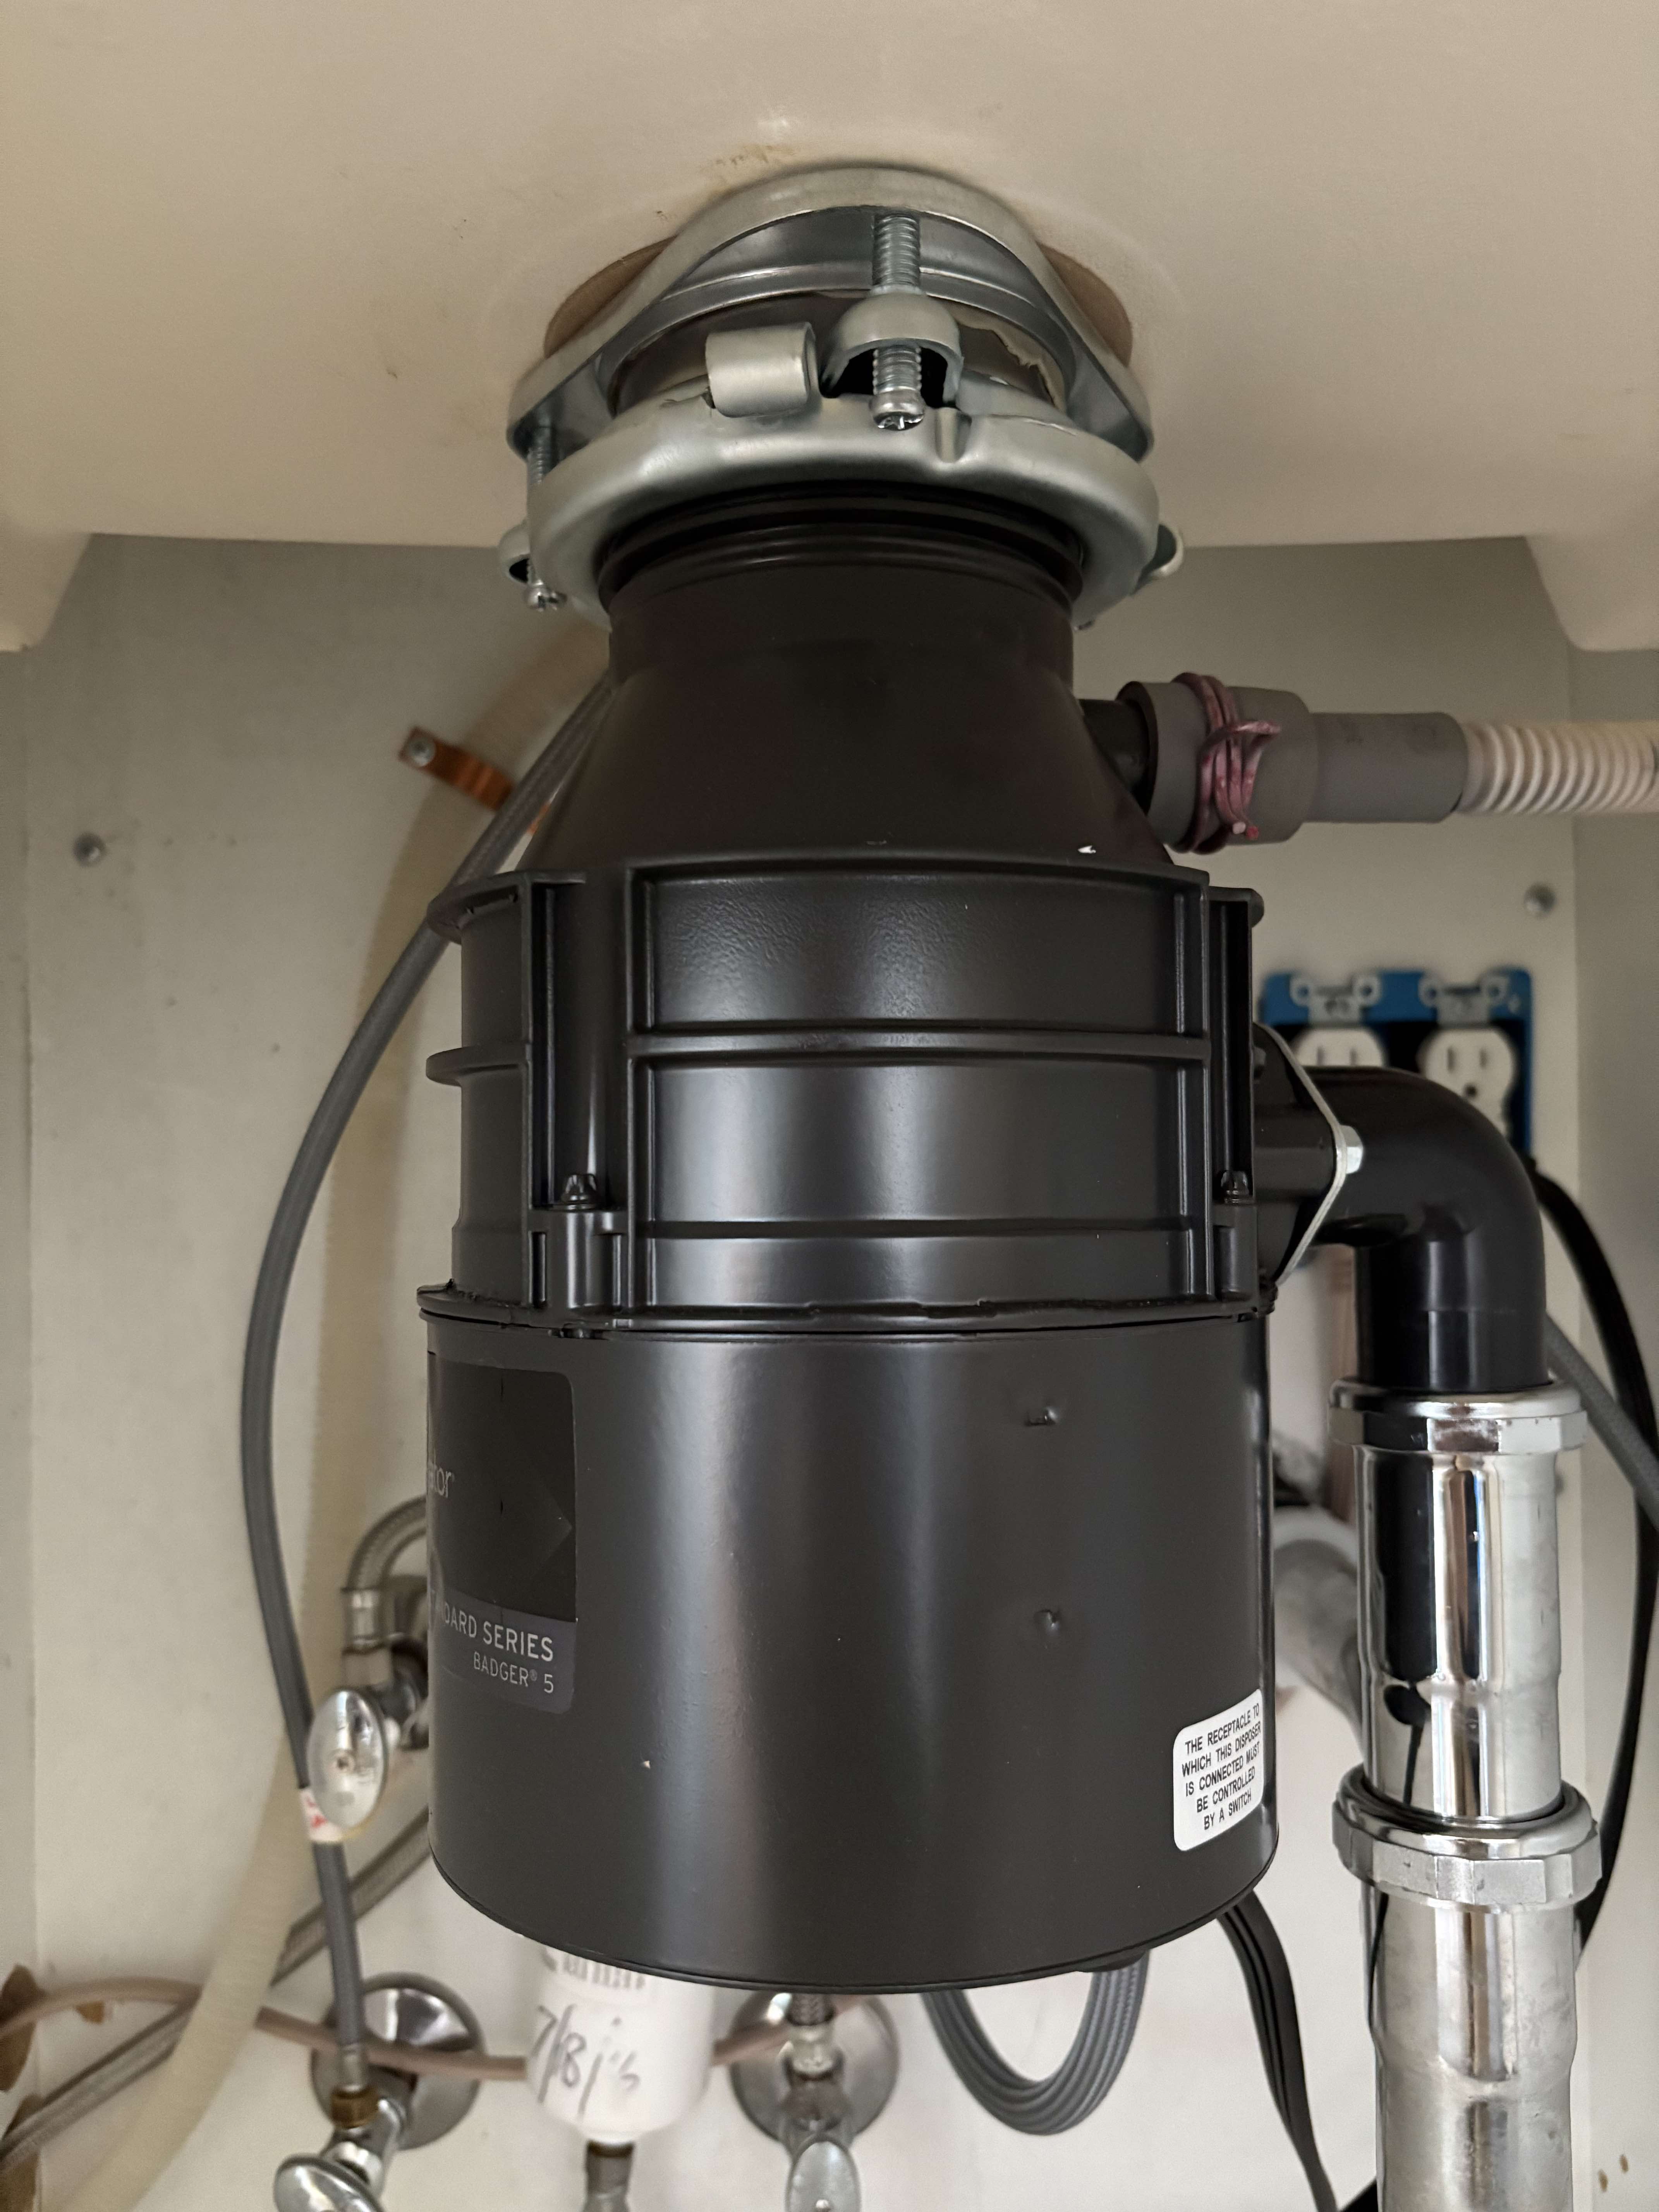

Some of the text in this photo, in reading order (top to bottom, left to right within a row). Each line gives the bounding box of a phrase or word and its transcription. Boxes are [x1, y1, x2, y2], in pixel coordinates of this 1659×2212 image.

[483, 1621, 553, 1662] SERIES
[544, 1673, 554, 1694] 5
[1182, 1721, 1261, 1777] WHICH THIS DISPOSER
[1185, 1703, 1259, 1755] THE RECEPTACLE TO
[1186, 1742, 1260, 1796] IS CONNECTED MUST
[1197, 1766, 1255, 1813] BE CONTROLLED
[1204, 1790, 1252, 1831] BY A SWITCH
